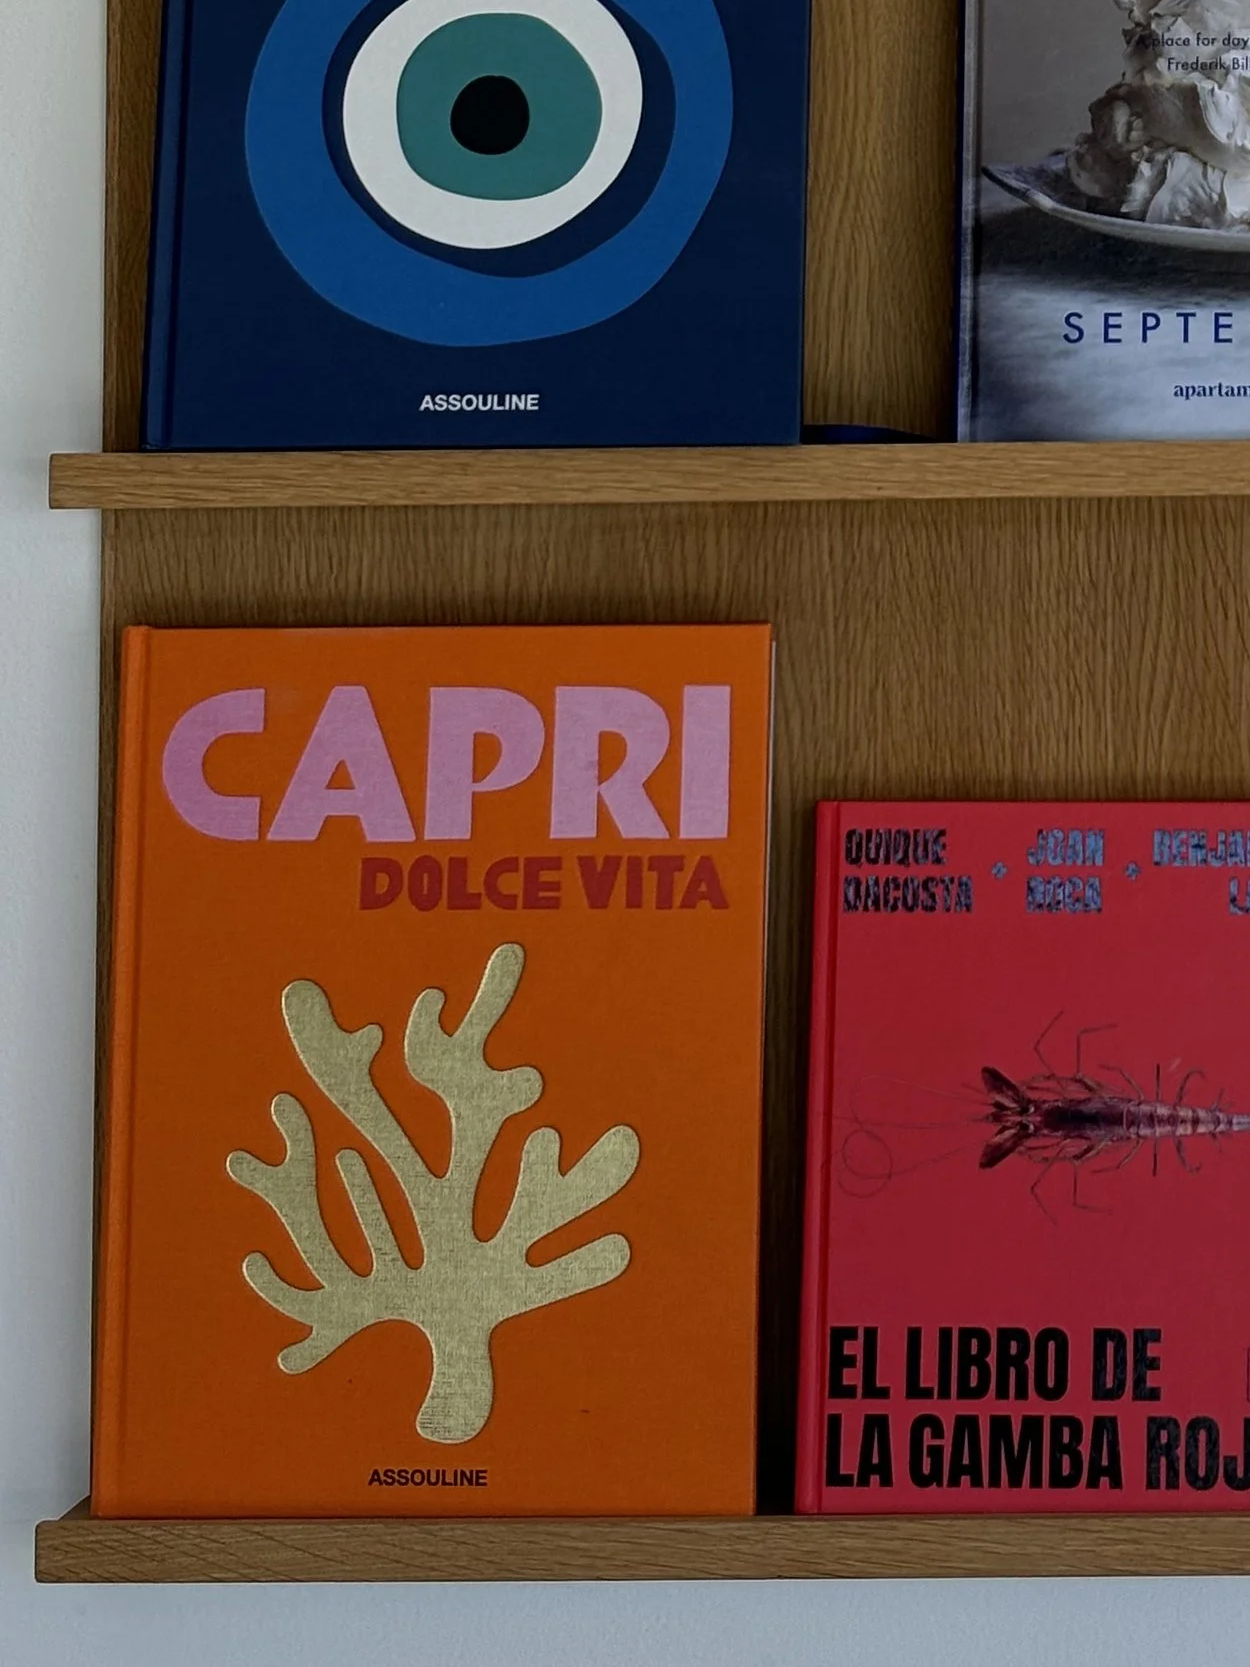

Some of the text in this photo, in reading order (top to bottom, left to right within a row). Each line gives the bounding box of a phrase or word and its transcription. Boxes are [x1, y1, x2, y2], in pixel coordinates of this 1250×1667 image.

[1152, 32, 1190, 50] place
[1196, 32, 1217, 46] for
[1167, 56, 1227, 71] Frederik
[419, 394, 540, 412] ASSOULINE
[162, 685, 731, 842] CAPRI
[843, 829, 948, 868] QUIQUE
[1027, 829, 1105, 866] JOAN
[359, 855, 730, 913] DOLCE VITA
[842, 876, 973, 914] DACOSTA
[1026, 877, 1103, 914] ROCA
[827, 1326, 1162, 1401] EL LIBRO DE
[824, 1414, 892, 1489] LA
[907, 1413, 1123, 1490] GAMBA
[368, 1469, 488, 1486] ASSOULINE
